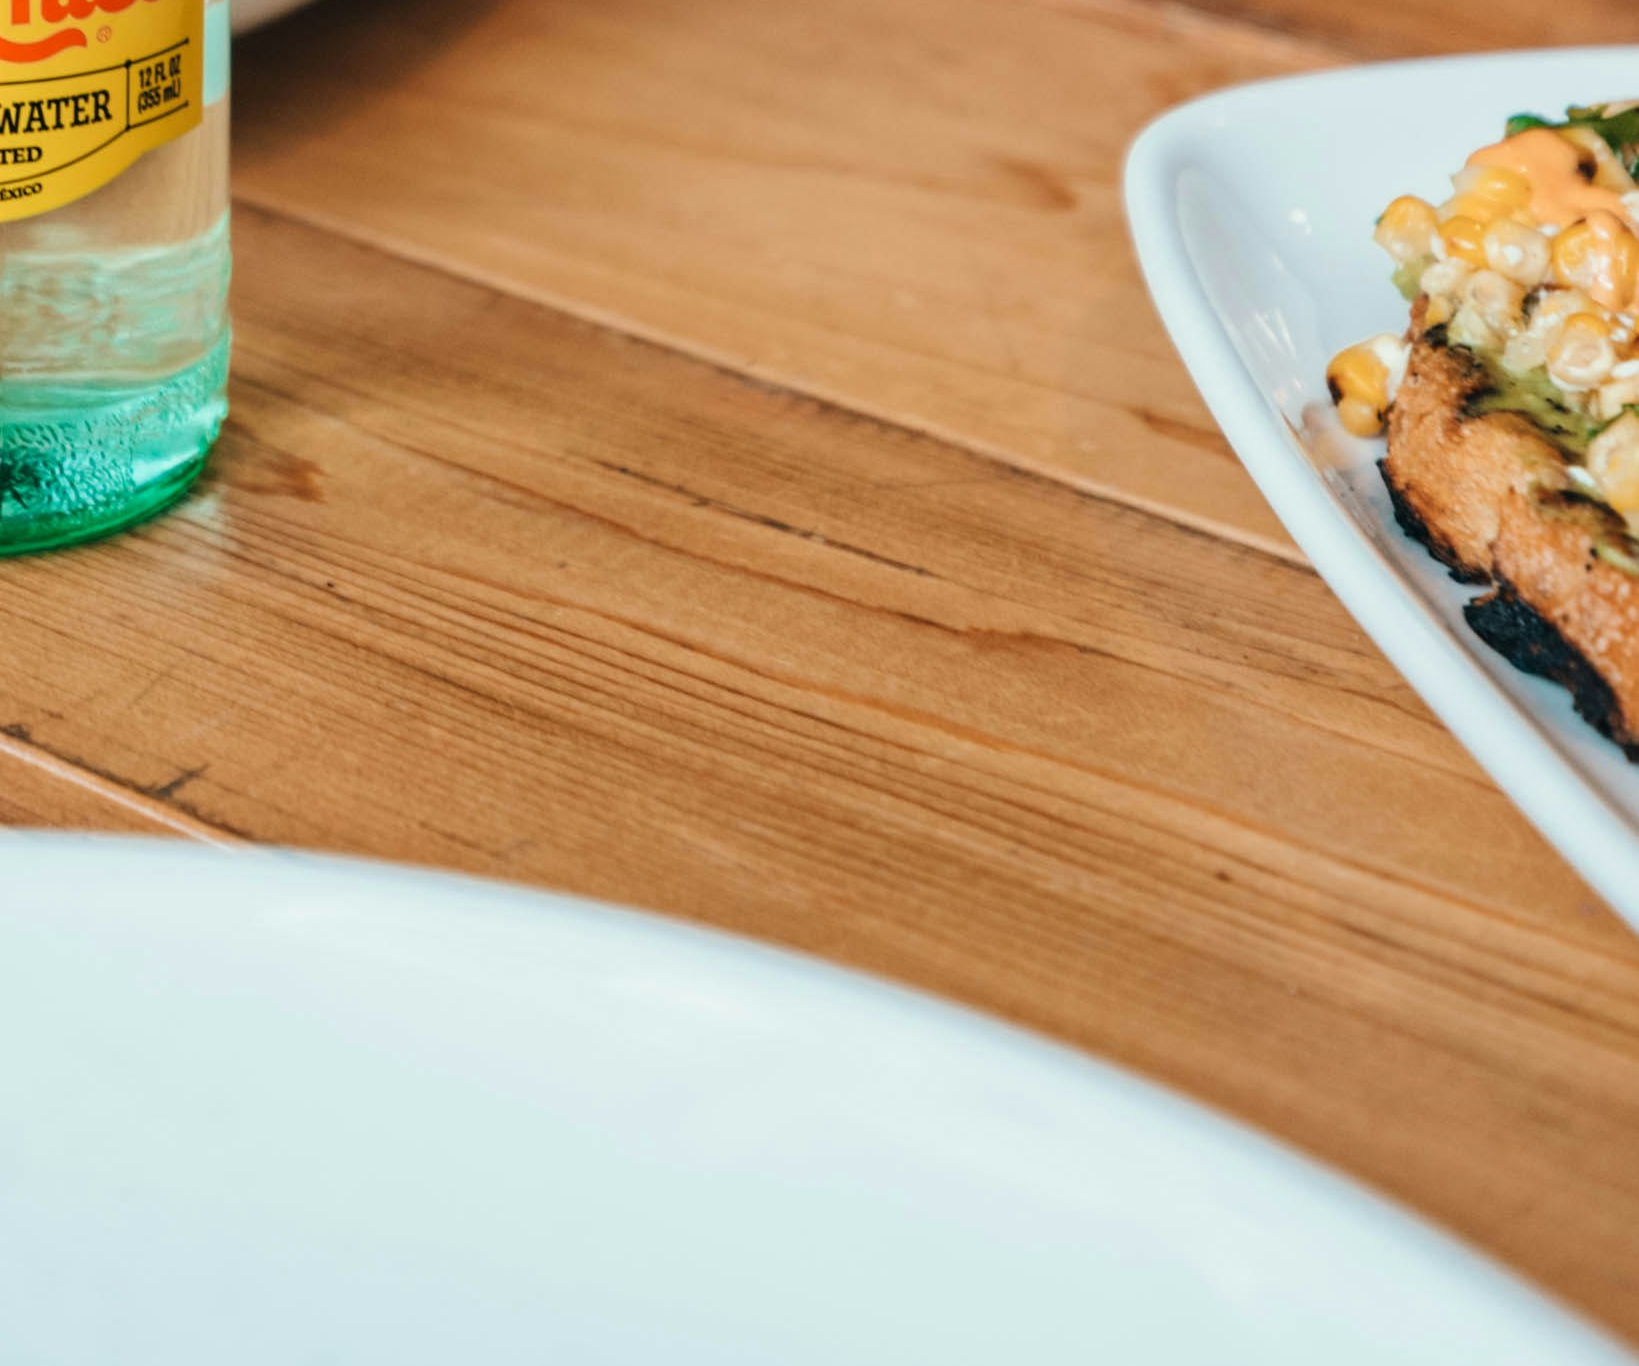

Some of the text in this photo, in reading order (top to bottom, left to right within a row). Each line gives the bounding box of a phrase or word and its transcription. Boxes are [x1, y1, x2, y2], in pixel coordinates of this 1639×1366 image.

[139, 67, 152, 89] 12
[154, 62, 167, 84] FL
[138, 86, 161, 114] (355
